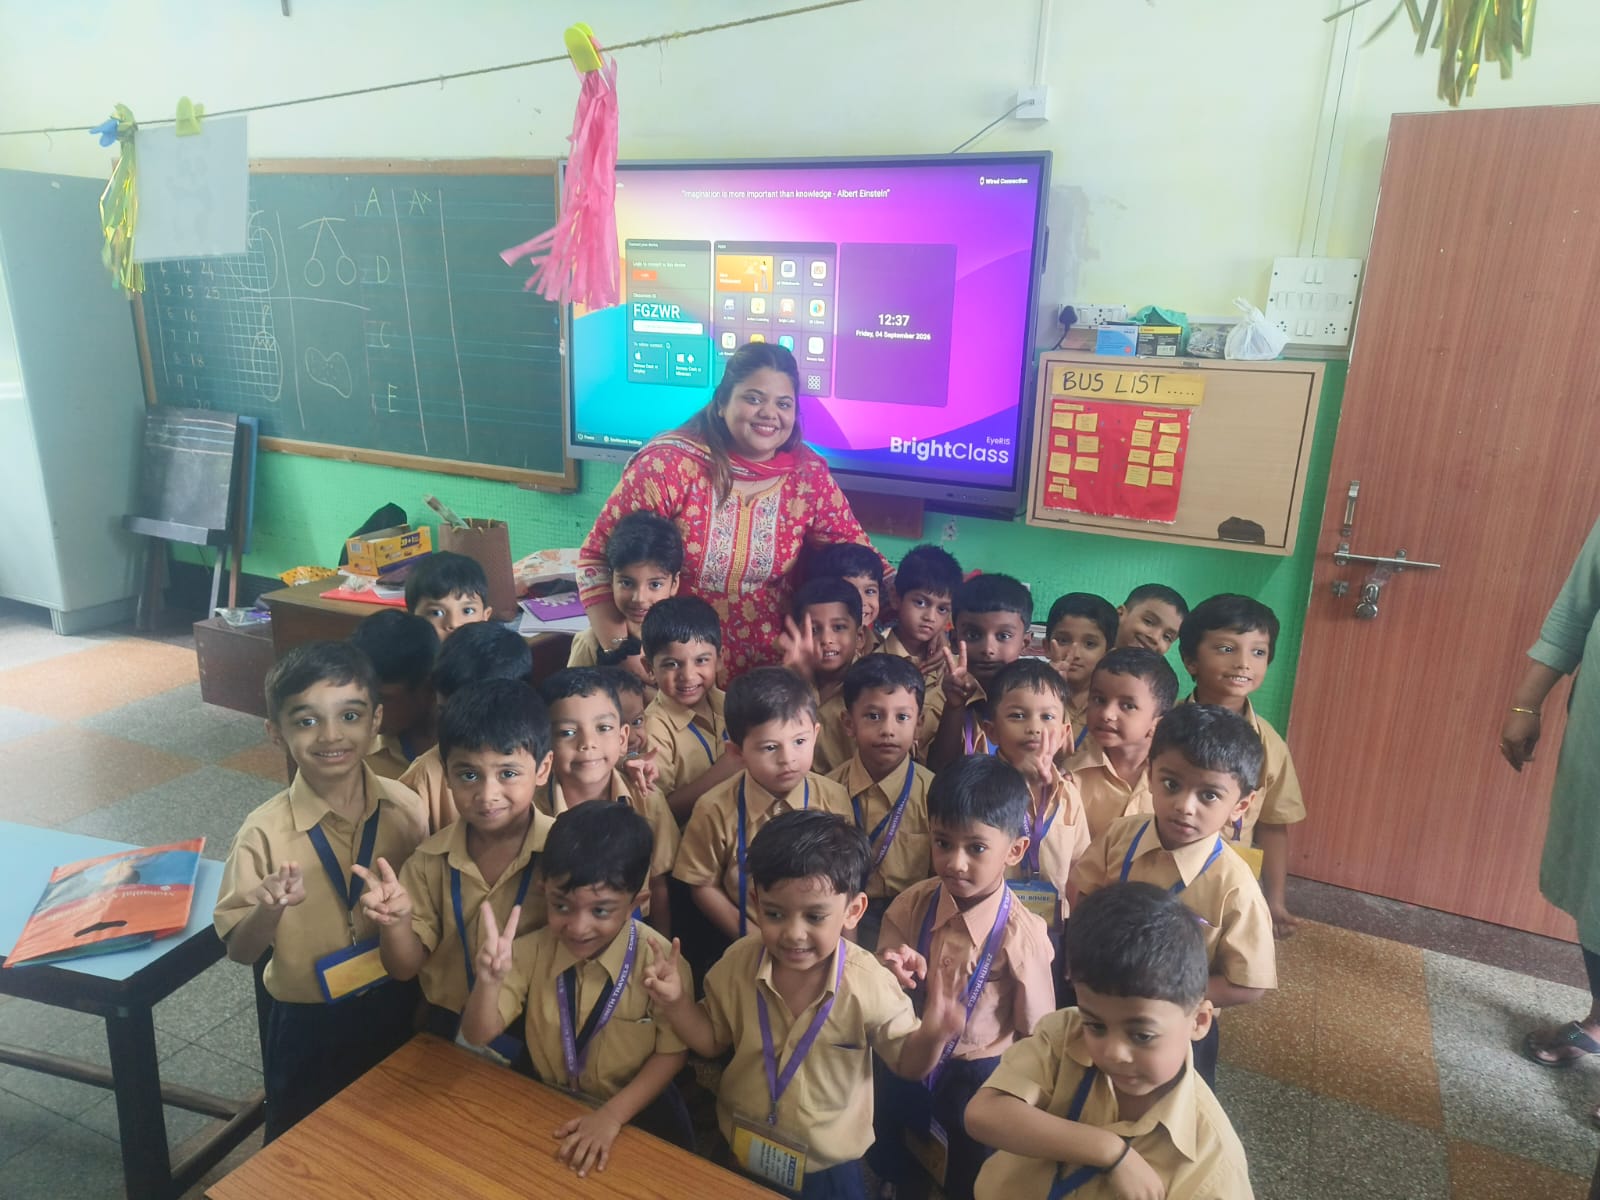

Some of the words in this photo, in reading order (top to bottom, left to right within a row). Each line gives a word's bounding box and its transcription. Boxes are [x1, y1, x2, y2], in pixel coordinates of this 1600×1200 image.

[364, 186, 382, 216] A
[728, 190, 745, 198] more
[747, 189, 778, 199] important
[779, 189, 794, 198] than
[795, 189, 832, 199] knowledge
[837, 188, 858, 198] Albert
[376, 255, 391, 284] D
[633, 303, 681, 319] FGZWR
[878, 313, 910, 327] 12:37
[855, 329, 874, 339] Friday,
[875, 330, 883, 338] 04
[884, 331, 915, 340] September
[1062, 371, 1104, 393] BUS
[388, 384, 399, 412] E
[890, 436, 1009, 464] BrightClass
[986, 436, 1010, 446] EyeRIS
[613, 962, 630, 997] TRAVELS
